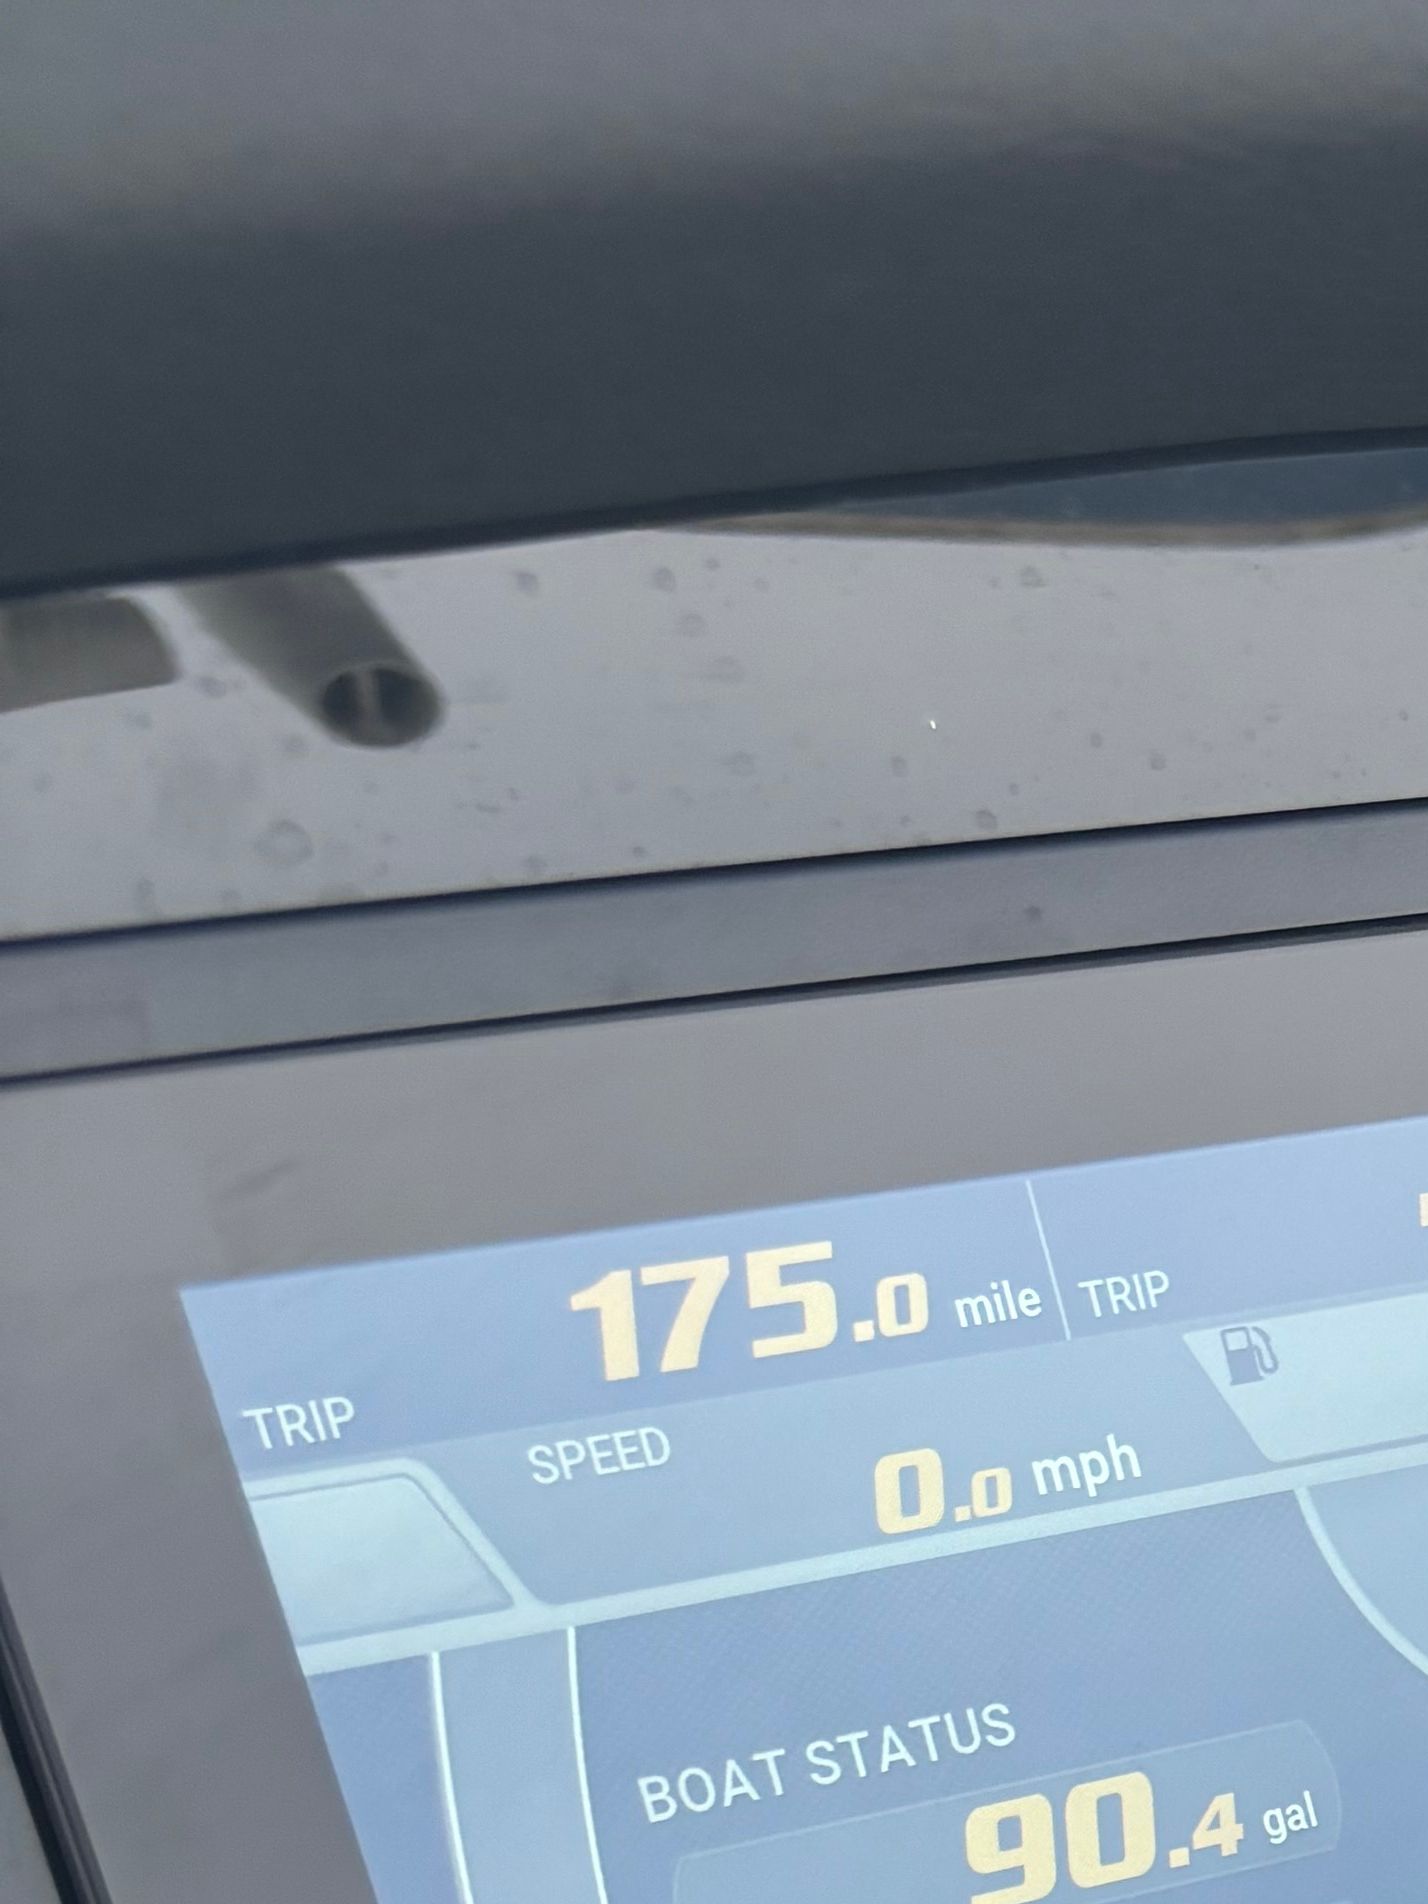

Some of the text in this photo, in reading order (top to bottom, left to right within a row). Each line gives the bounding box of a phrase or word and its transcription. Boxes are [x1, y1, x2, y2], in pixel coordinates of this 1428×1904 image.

[569, 1241, 1043, 1382] 175.0 mile
[1078, 1270, 1171, 1321] TRIP
[242, 1396, 356, 1453] TRIP
[526, 1426, 671, 1486] SPEED
[873, 1436, 1143, 1535] 0.0 mph
[637, 1702, 1017, 1823] BOAT STATUS
[1262, 1791, 1319, 1846] gal
